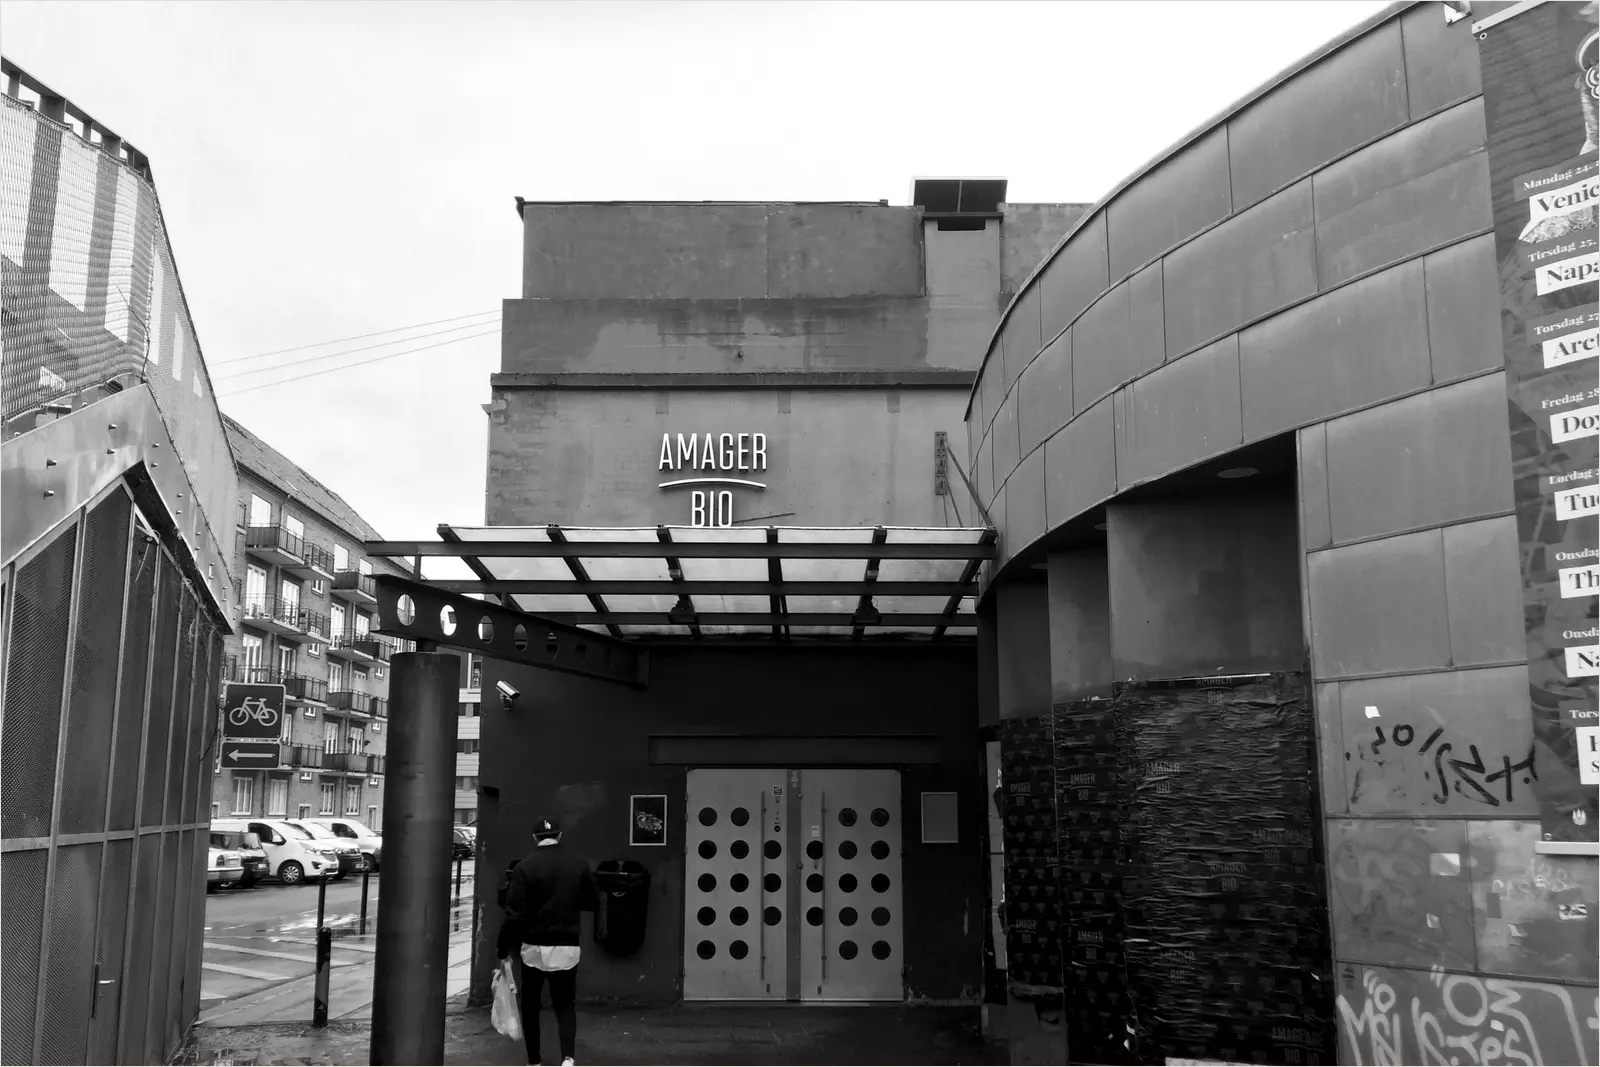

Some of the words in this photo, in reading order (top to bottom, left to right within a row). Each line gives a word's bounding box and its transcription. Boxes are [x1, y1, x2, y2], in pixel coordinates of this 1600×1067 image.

[1524, 169, 1573, 190] Mandag
[1538, 184, 1599, 211] Venic
[1528, 242, 1576, 262] Tirsdag
[1534, 315, 1584, 335] Torsdag
[1542, 392, 1584, 409] Fredag
[658, 432, 767, 470] AMAGER
[691, 490, 733, 527] BIO
[1070, 773, 1096, 784] AMAGER
[1221, 877, 1237, 891] BIO
